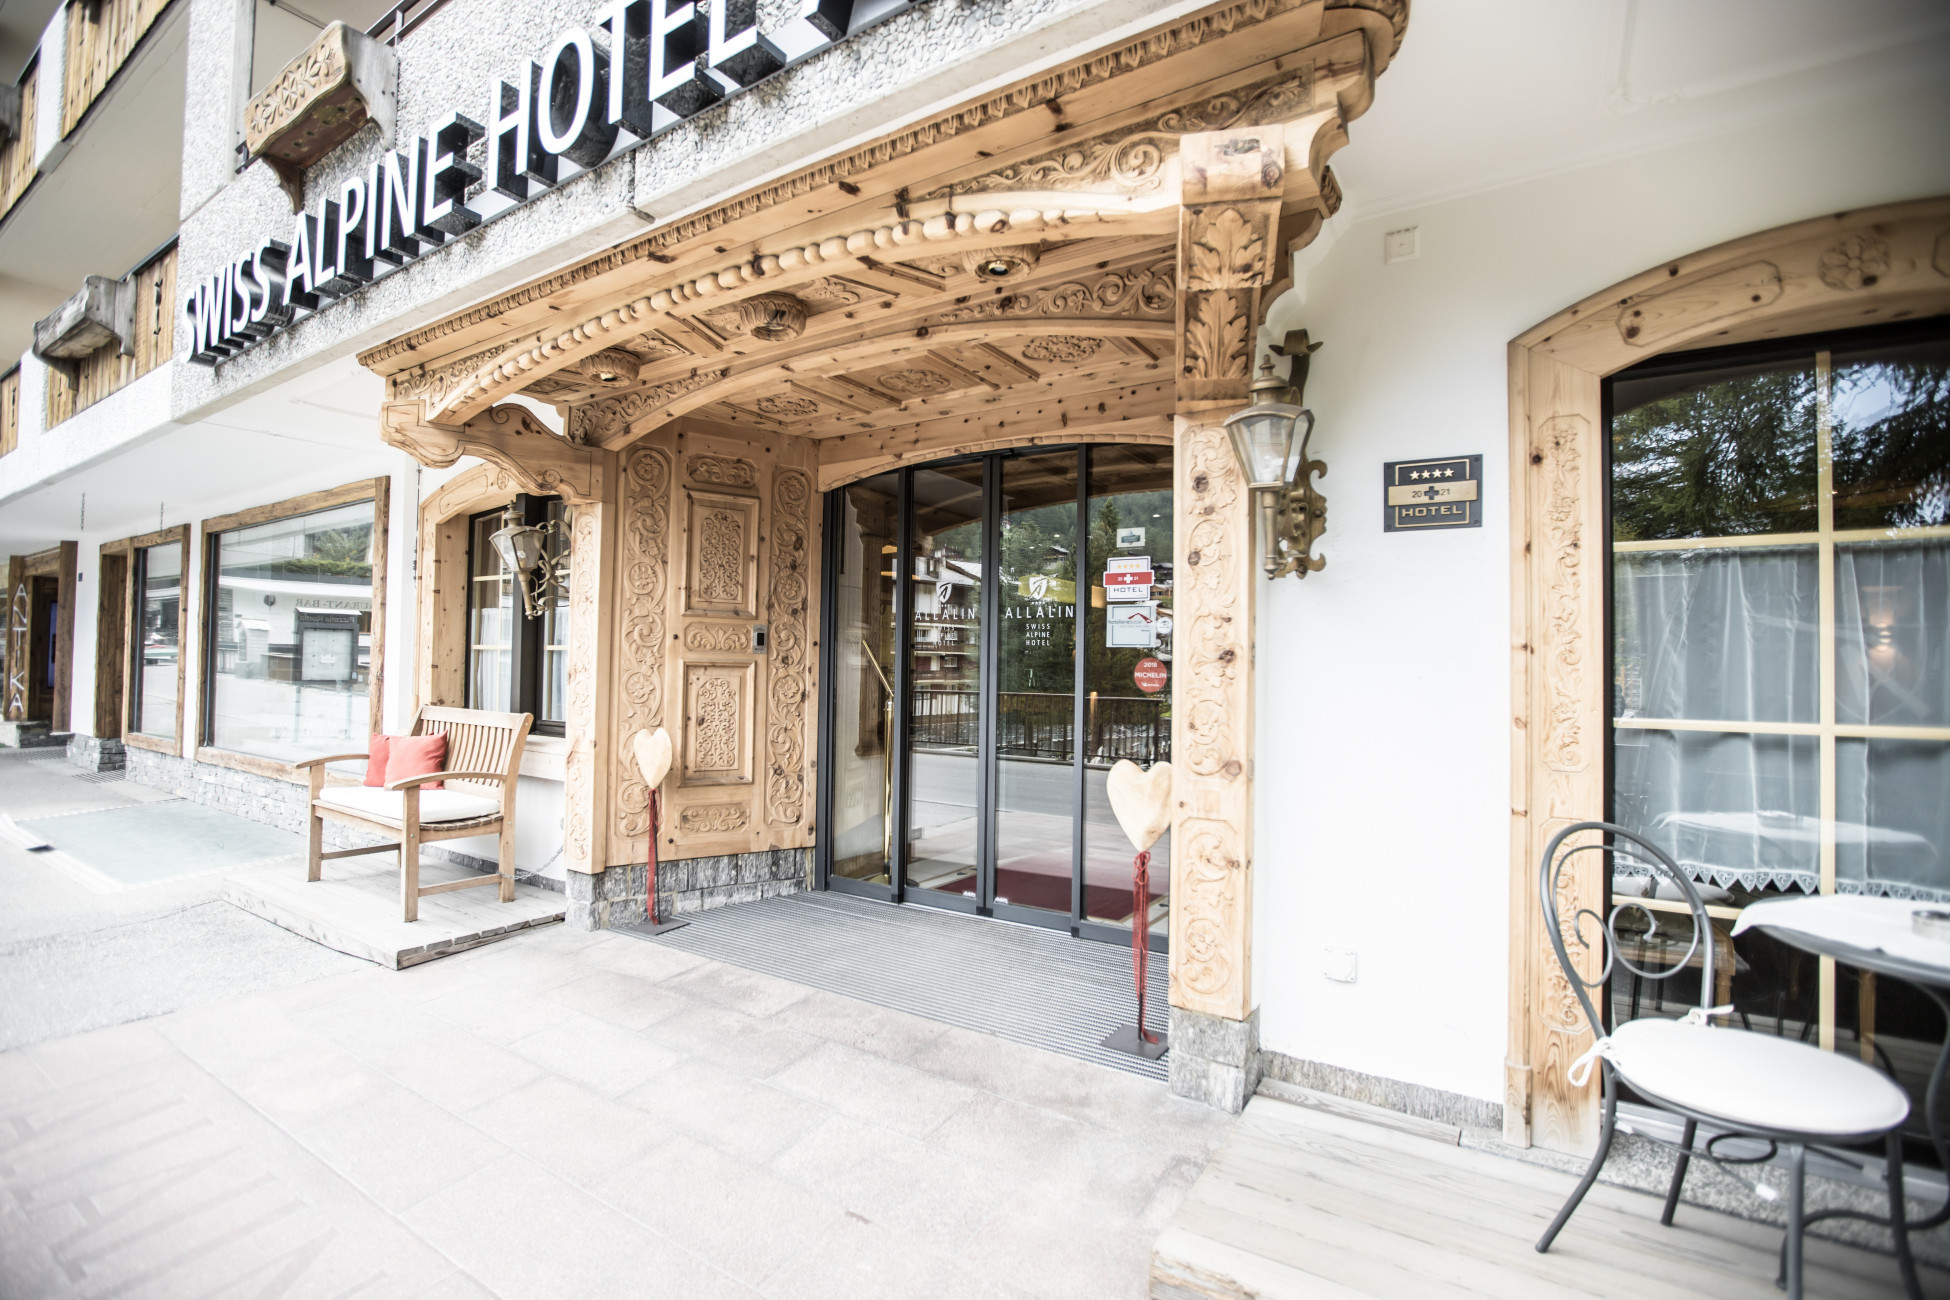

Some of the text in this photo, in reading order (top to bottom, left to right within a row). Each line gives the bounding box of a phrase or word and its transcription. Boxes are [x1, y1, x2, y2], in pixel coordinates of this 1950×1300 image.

[181, 0, 757, 363] SWISS ALPINE HOTEL
[1412, 488, 1451, 498] 20 21
[1401, 505, 1463, 517] HOTEL
[914, 608, 975, 621] ALLALIN
[1005, 605, 1074, 619] ALLALIN
[9, 583, 28, 713] ANTIKA
[1134, 671, 1167, 679] MICHELIN
